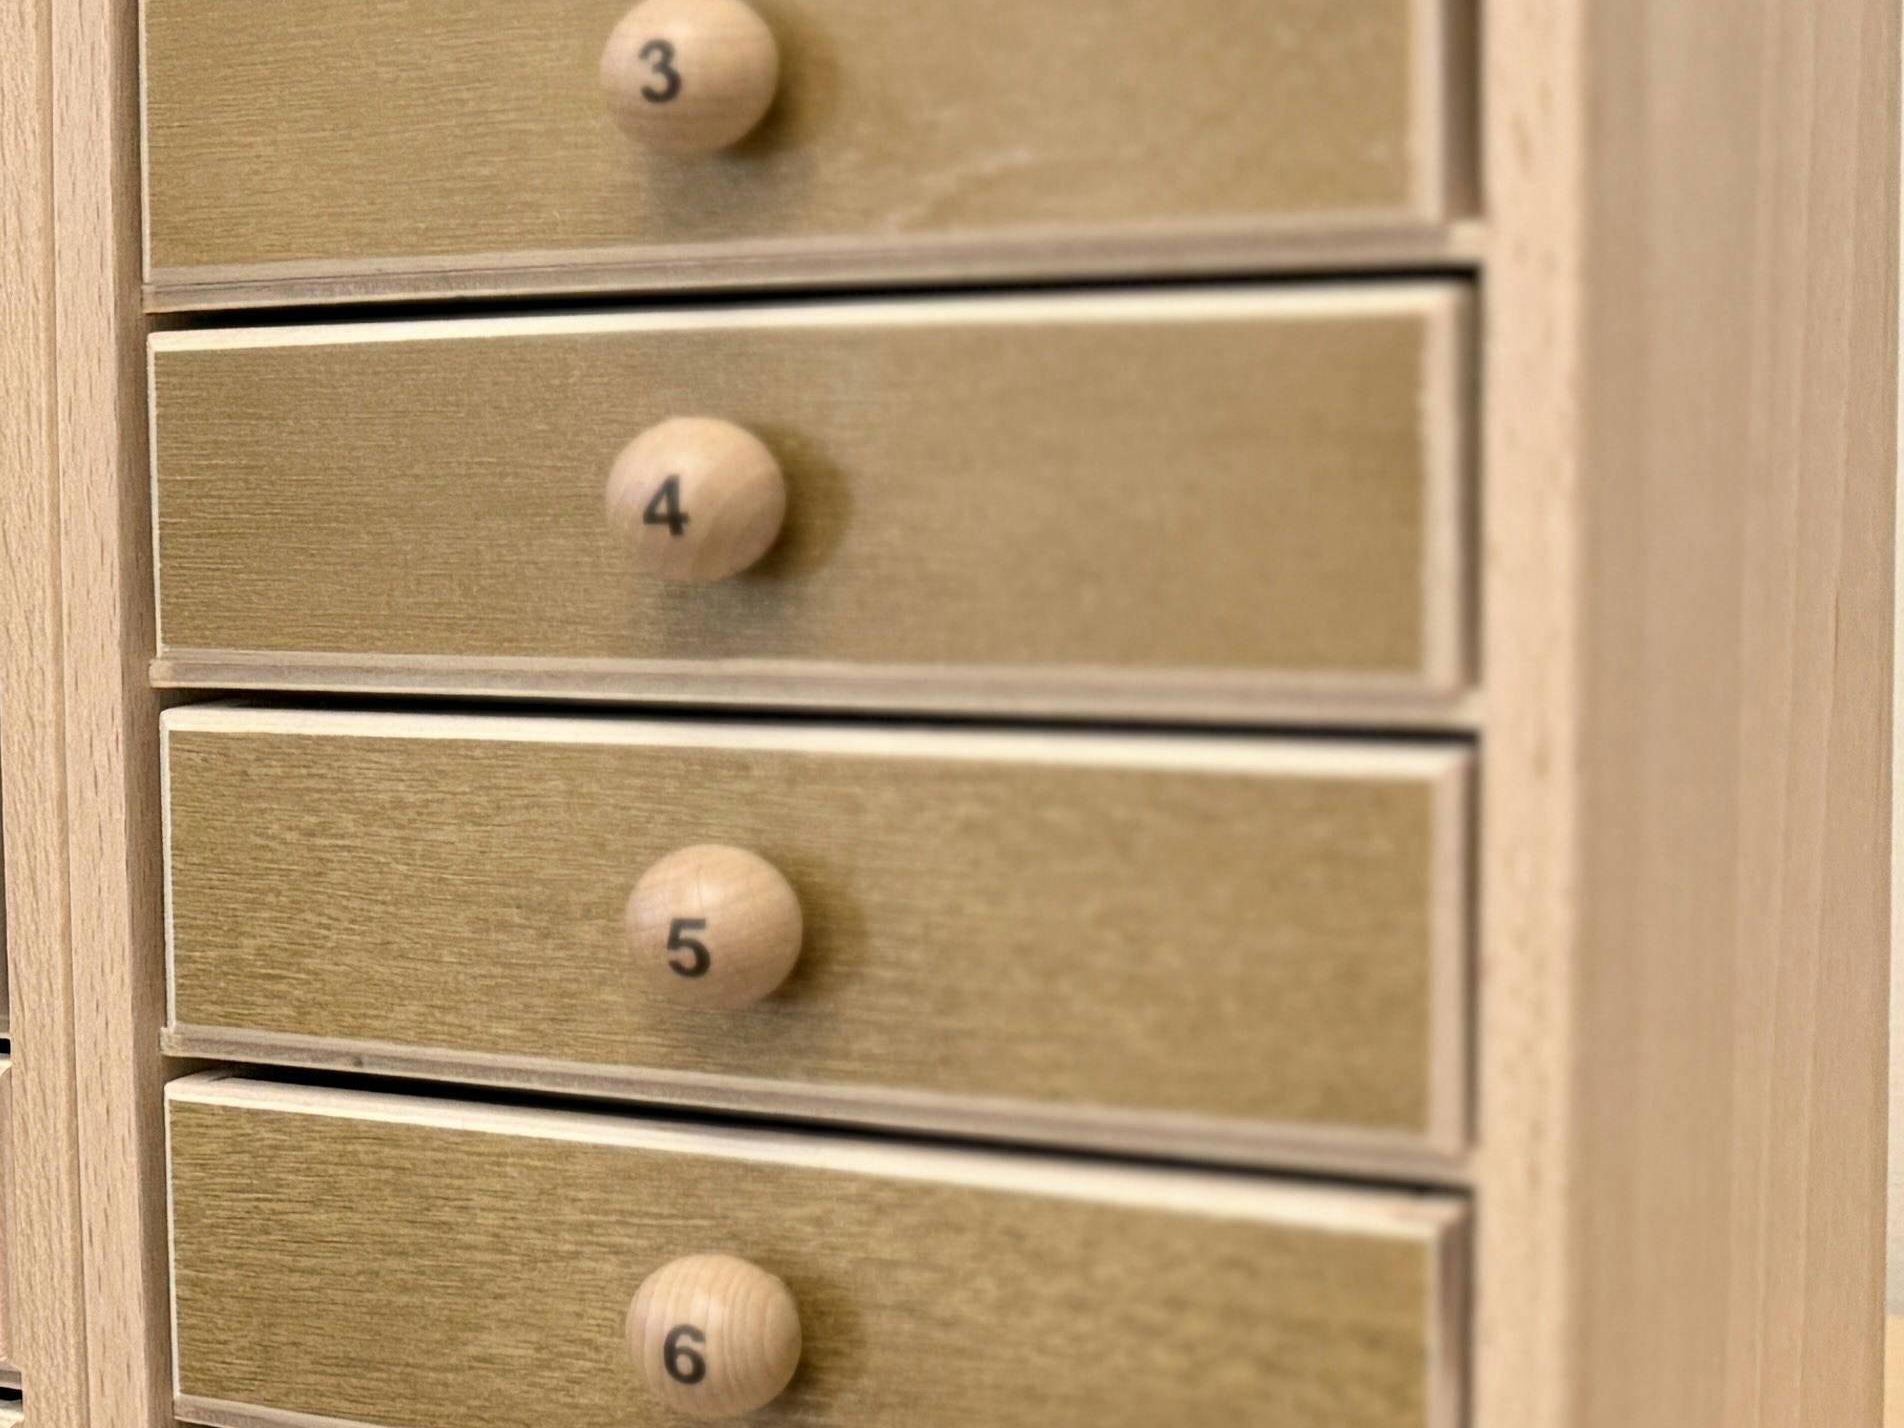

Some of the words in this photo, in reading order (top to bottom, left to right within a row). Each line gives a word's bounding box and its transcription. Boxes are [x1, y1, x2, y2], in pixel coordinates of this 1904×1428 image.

[639, 39, 682, 104] 3
[642, 474, 689, 538] 4
[666, 917, 711, 980] 5
[663, 1324, 707, 1386] 6
